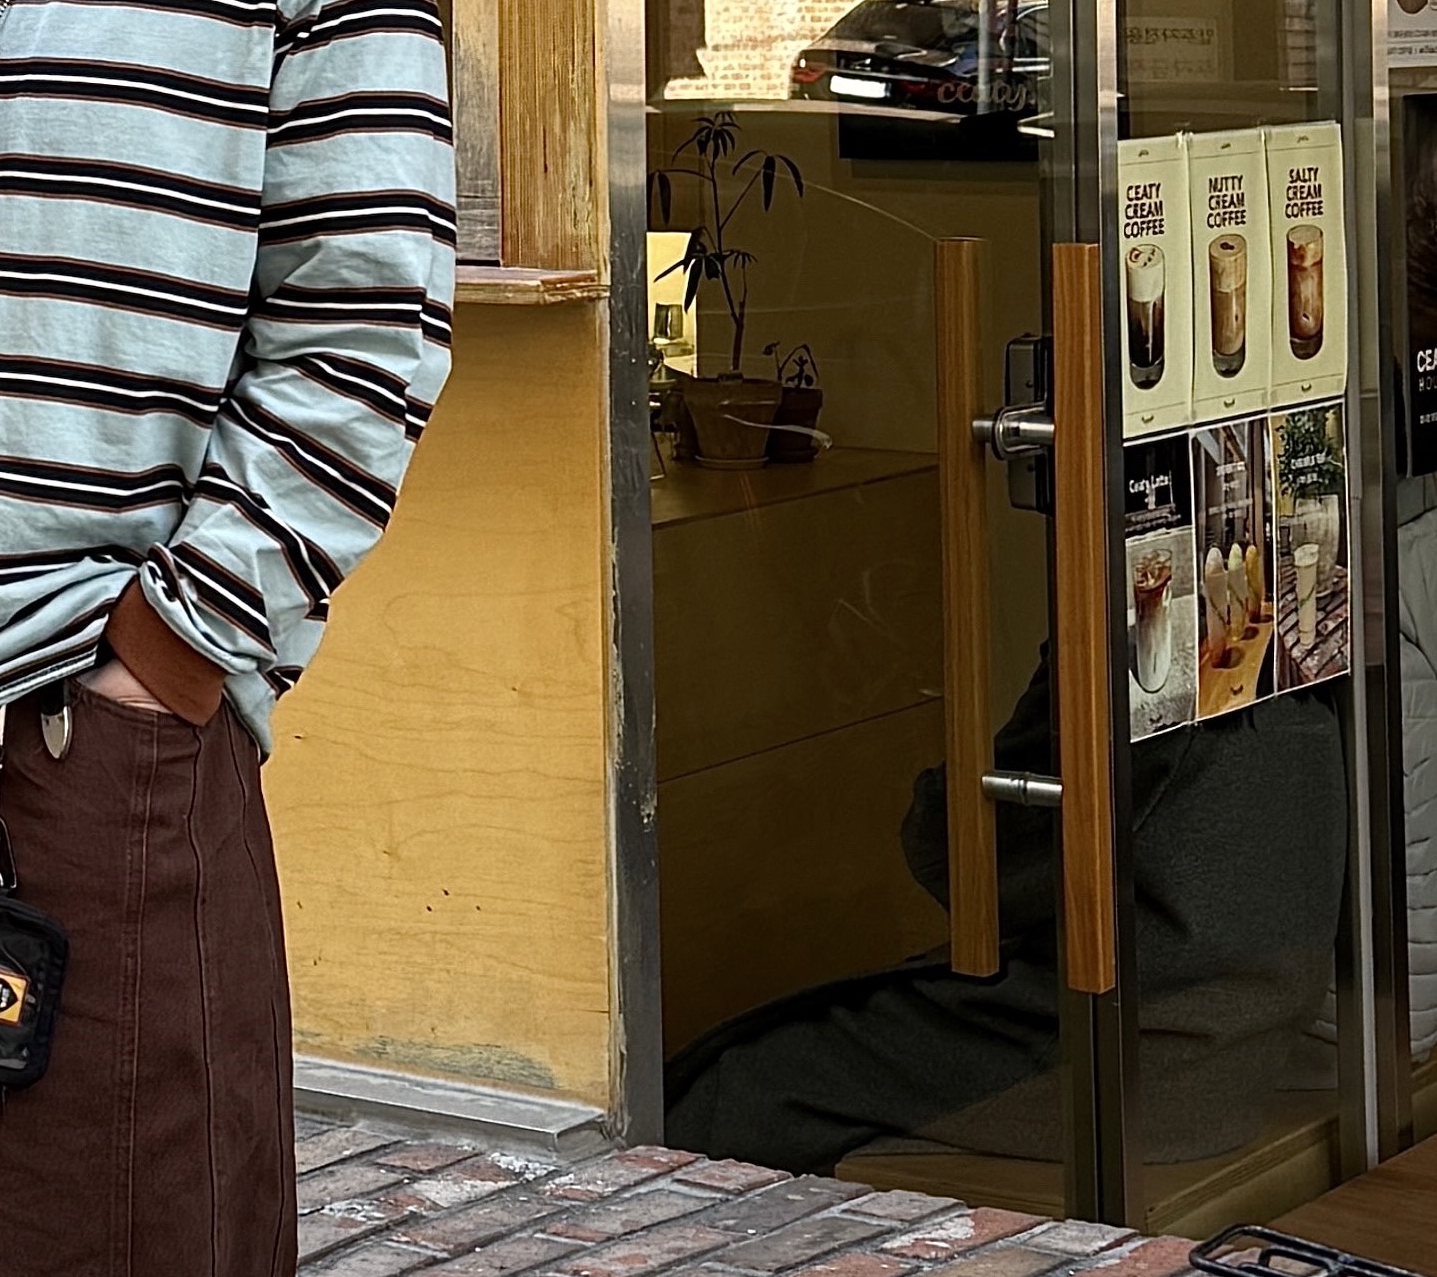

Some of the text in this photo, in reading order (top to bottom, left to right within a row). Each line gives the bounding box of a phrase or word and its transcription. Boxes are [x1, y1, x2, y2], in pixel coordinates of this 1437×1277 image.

[1208, 175, 1244, 193] NUTTY
[1288, 167, 1319, 184] SALTY
[1126, 182, 1162, 202] CEATY
[1208, 192, 1245, 211] CREAM
[1286, 183, 1322, 201] CREAM
[1124, 200, 1164, 220] CREAM
[1206, 209, 1247, 229] COFFEE
[1285, 200, 1324, 219] COFFEE
[1123, 218, 1165, 239] COFFEE
